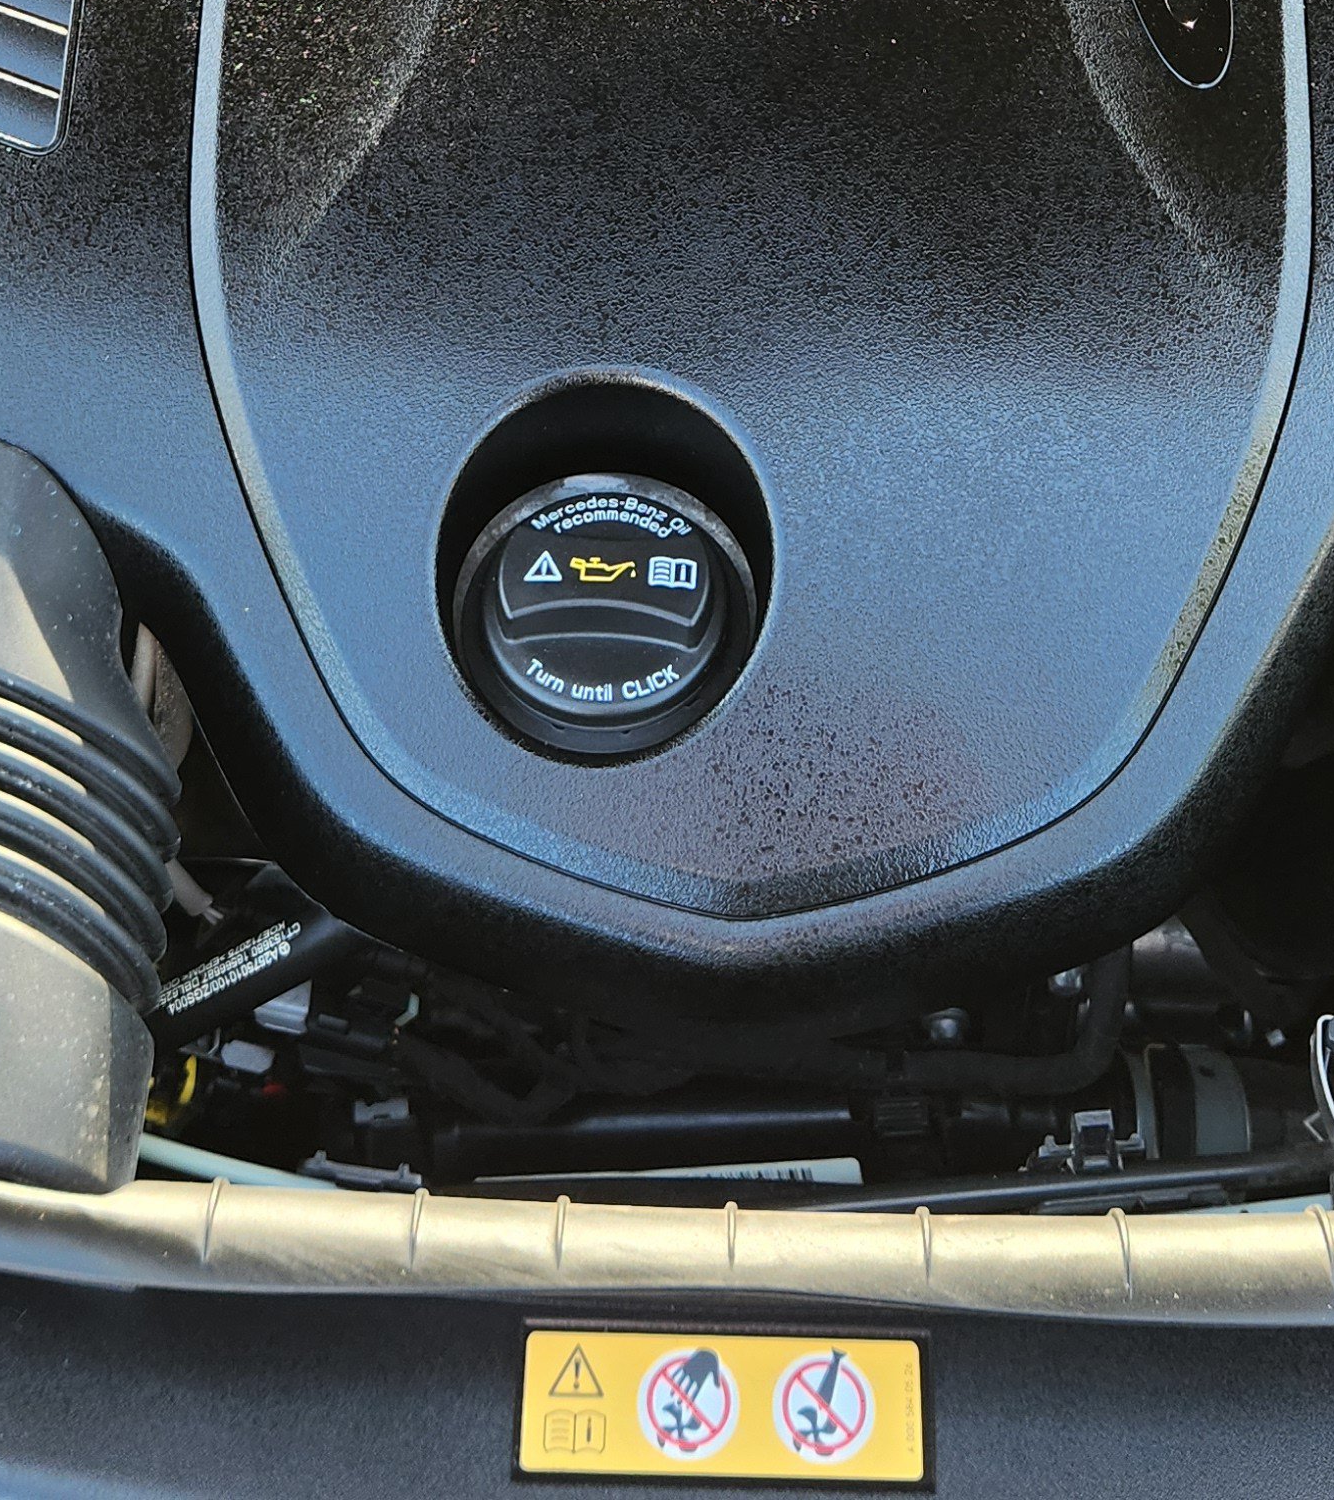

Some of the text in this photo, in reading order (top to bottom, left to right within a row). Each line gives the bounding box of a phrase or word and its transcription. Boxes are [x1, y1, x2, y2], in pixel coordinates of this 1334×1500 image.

[530, 496, 693, 537] Mercedes-Benz Oil
[554, 509, 674, 539] recommended
[525, 658, 681, 702] Turn until CLICK
